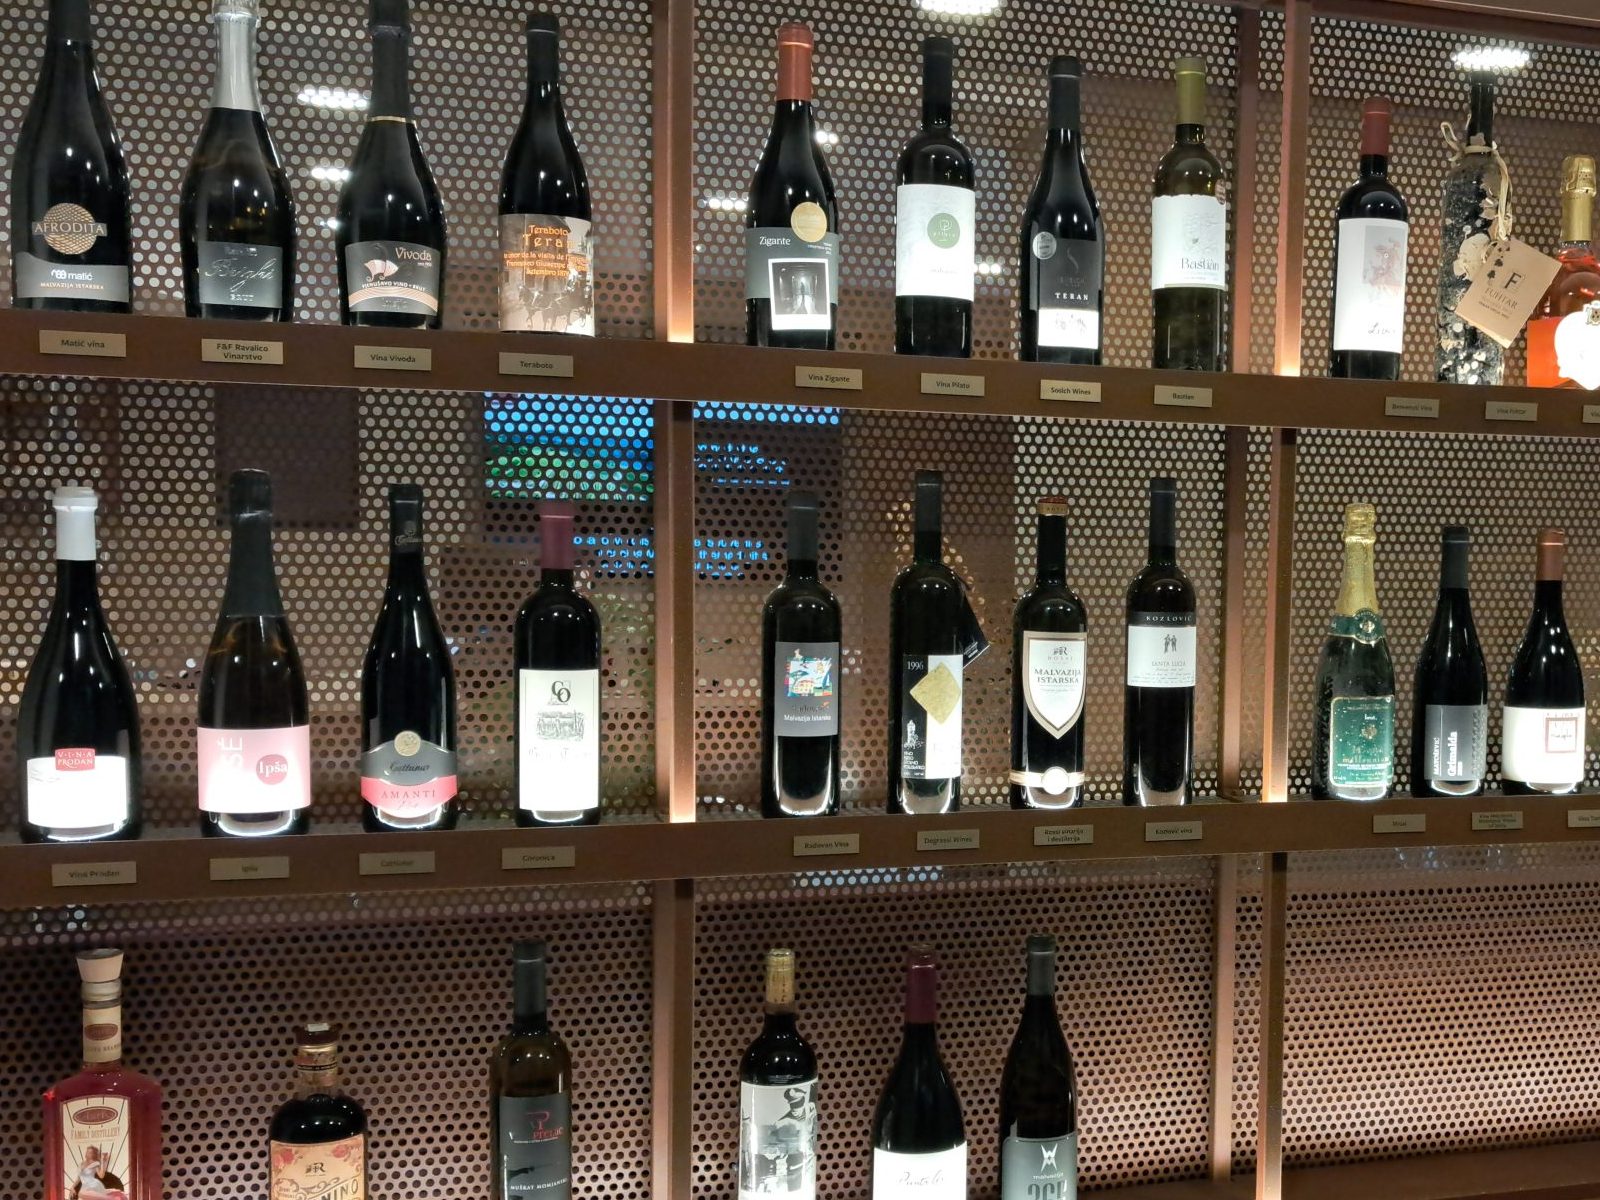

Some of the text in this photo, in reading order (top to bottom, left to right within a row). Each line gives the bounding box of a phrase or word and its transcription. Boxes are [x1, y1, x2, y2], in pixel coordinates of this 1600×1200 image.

[34, 222, 104, 234] AFRODITA
[759, 236, 791, 247] Zigante
[395, 247, 432, 261] Vivoda
[1504, 272, 1522, 289] F
[1054, 292, 1089, 301] TERAN
[61, 339, 85, 348] Matić
[235, 344, 269, 352] Ravalico
[223, 352, 263, 361] Vinarstvo
[370, 354, 416, 363] Vina Vivoda
[825, 374, 850, 383] Zigante
[1072, 387, 1091, 395] Wines
[1146, 614, 1192, 622] KOZLOVIĆ
[1034, 668, 1081, 677] MALVAZIJA
[1037, 676, 1079, 684] ISTARSKA
[57, 758, 93, 767] PRODAN
[259, 760, 288, 778] Ipša
[381, 789, 436, 799] AMANTI
[71, 1126, 120, 1140] FAMILY DISTILLERY
